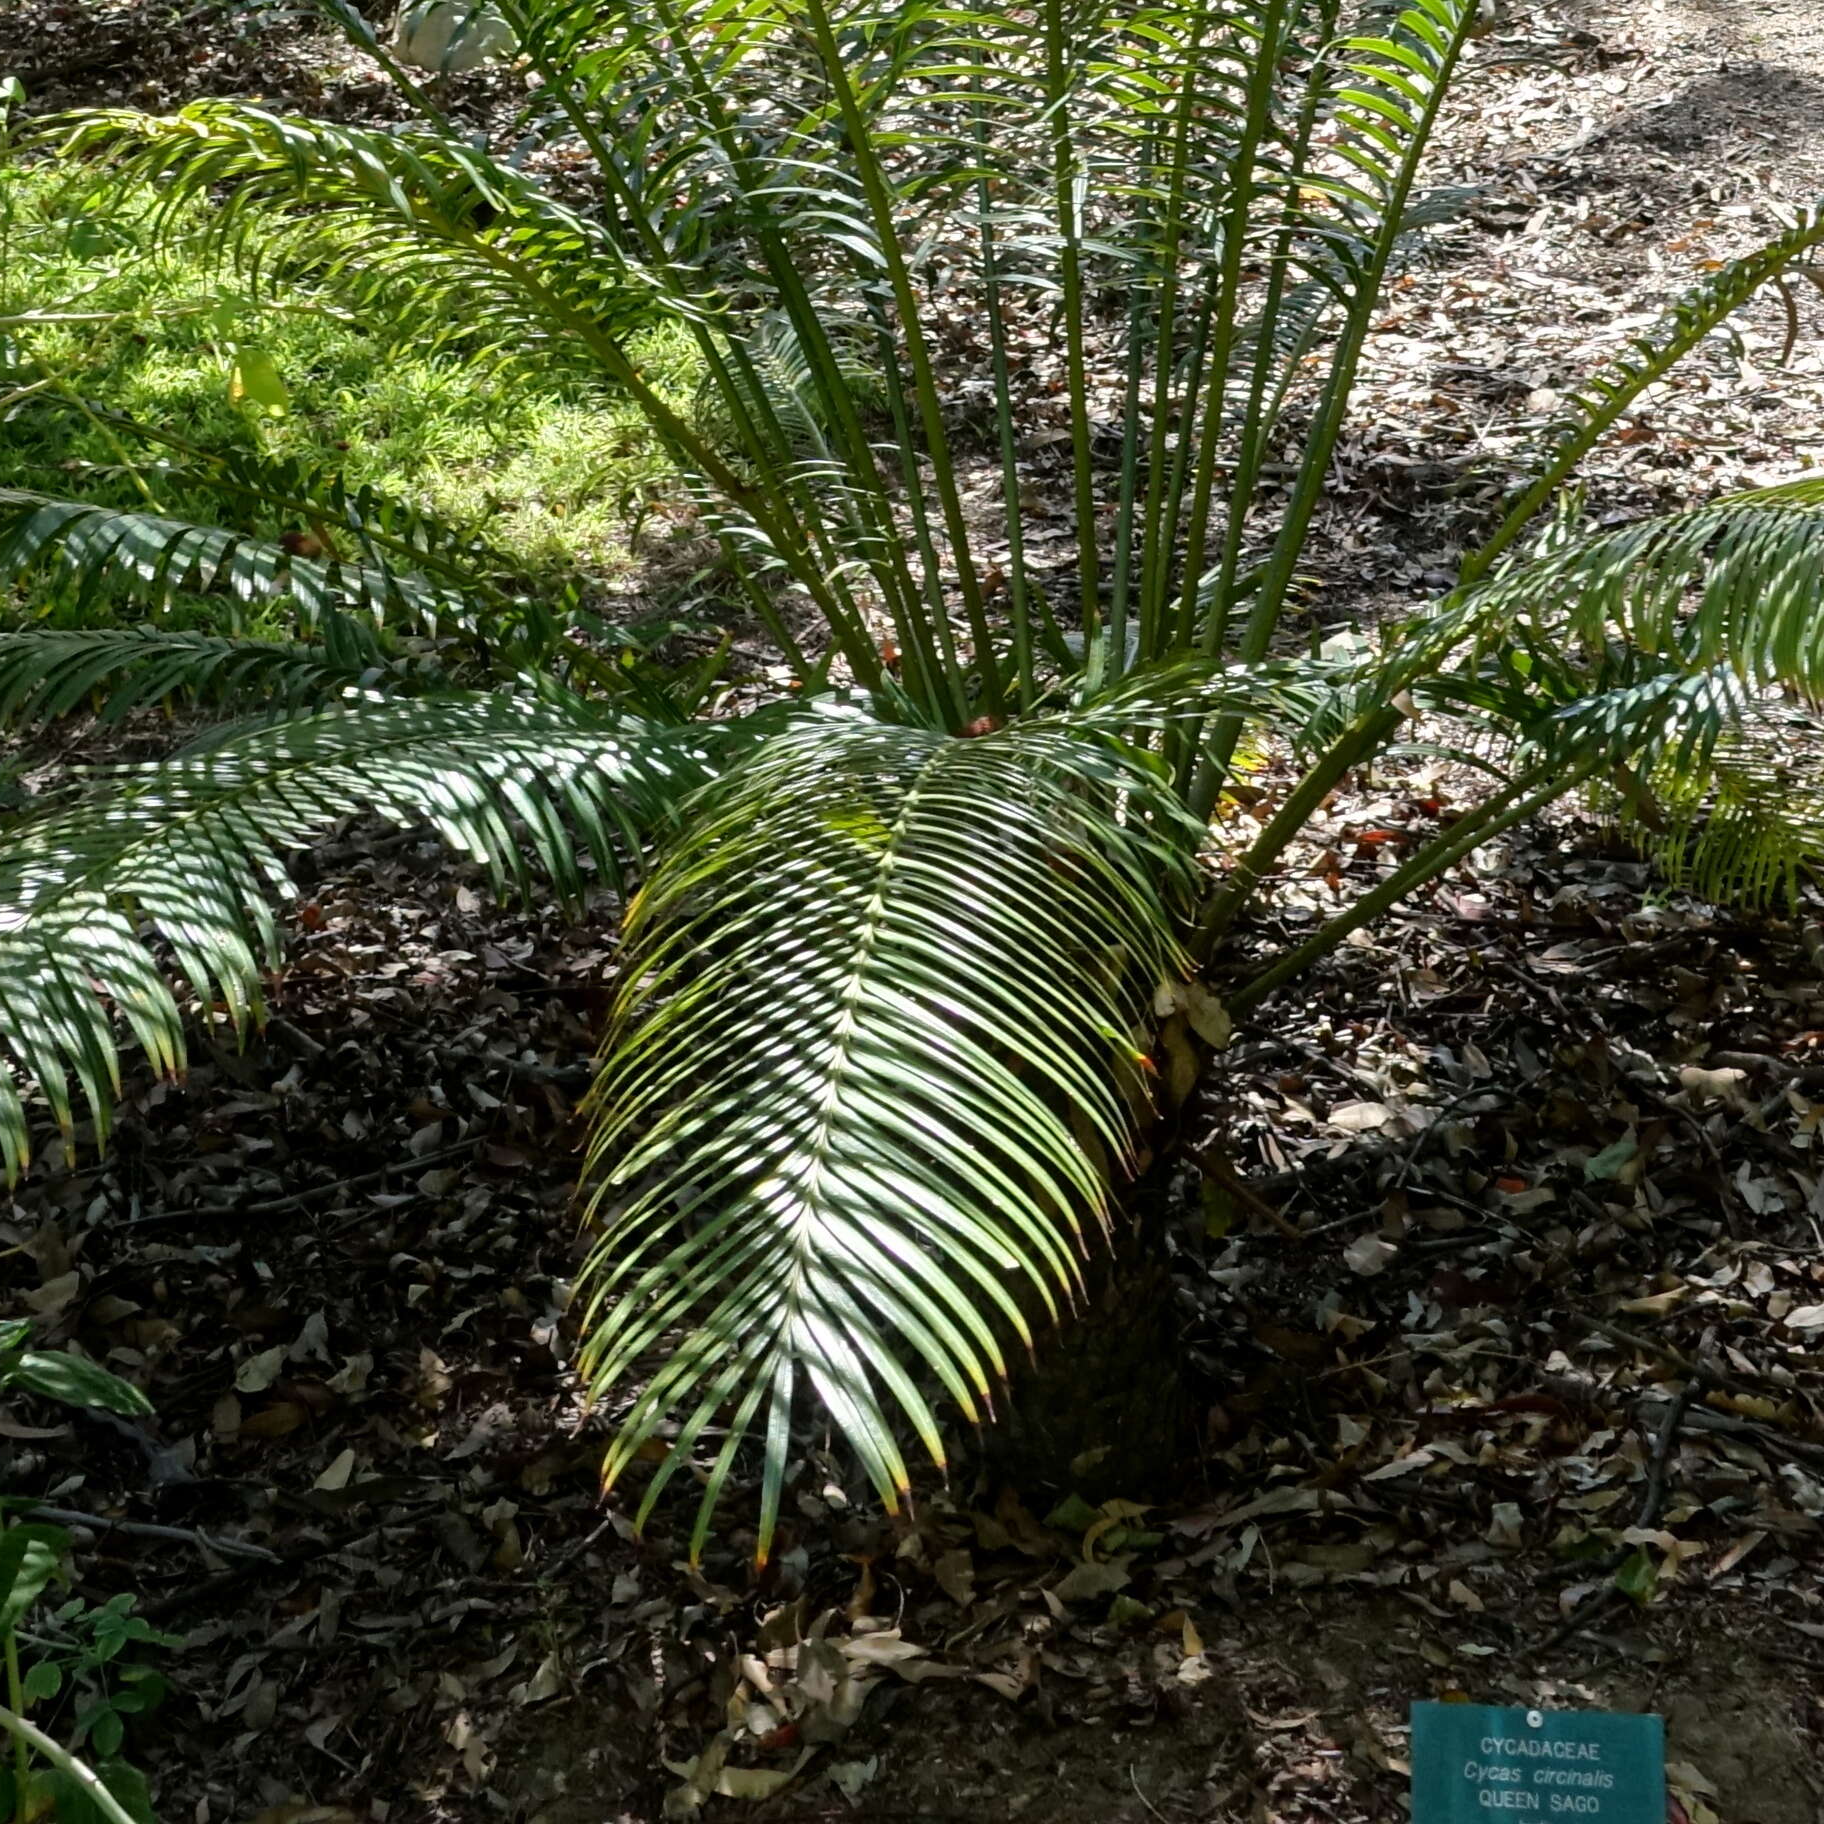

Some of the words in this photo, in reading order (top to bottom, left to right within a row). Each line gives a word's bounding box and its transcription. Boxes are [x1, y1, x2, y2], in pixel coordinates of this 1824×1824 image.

[1481, 1737, 1600, 1760] CYCADACEAE
[1464, 1761, 1521, 1783] Cycas
[1533, 1766, 1614, 1788] circinalis
[1479, 1790, 1539, 1809] QUEEN
[1551, 1795, 1599, 1813] SAGO
